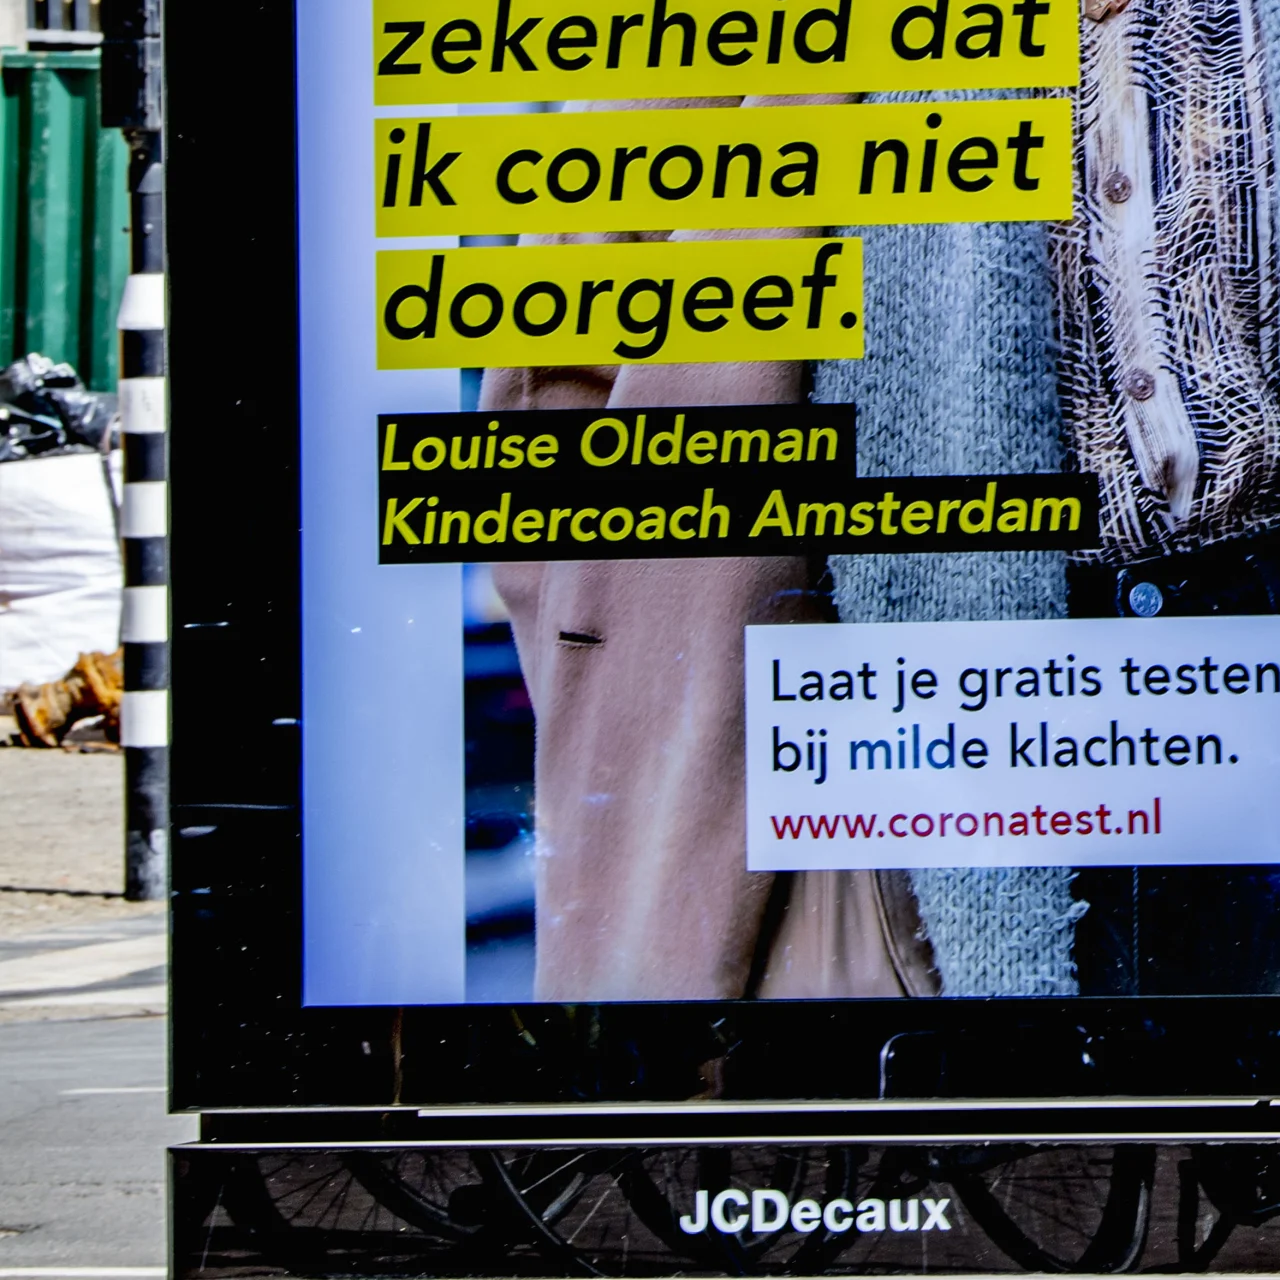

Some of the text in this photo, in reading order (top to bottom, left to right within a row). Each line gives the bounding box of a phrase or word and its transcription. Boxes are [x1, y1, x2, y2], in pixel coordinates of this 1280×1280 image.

[382, 112, 1045, 209] ik corona niet
[383, 242, 858, 360] doorgeef.
[381, 414, 839, 472] Louise Oldeman
[381, 482, 1082, 546] Kindercoach Amsterdam
[771, 658, 878, 703] Laat
[892, 656, 939, 714] je
[958, 653, 1103, 712] gratis
[771, 720, 1240, 786] bij milde klachten.
[770, 797, 1162, 841] www.coronatest.nl
[679, 1188, 953, 1235] JCDecaux
